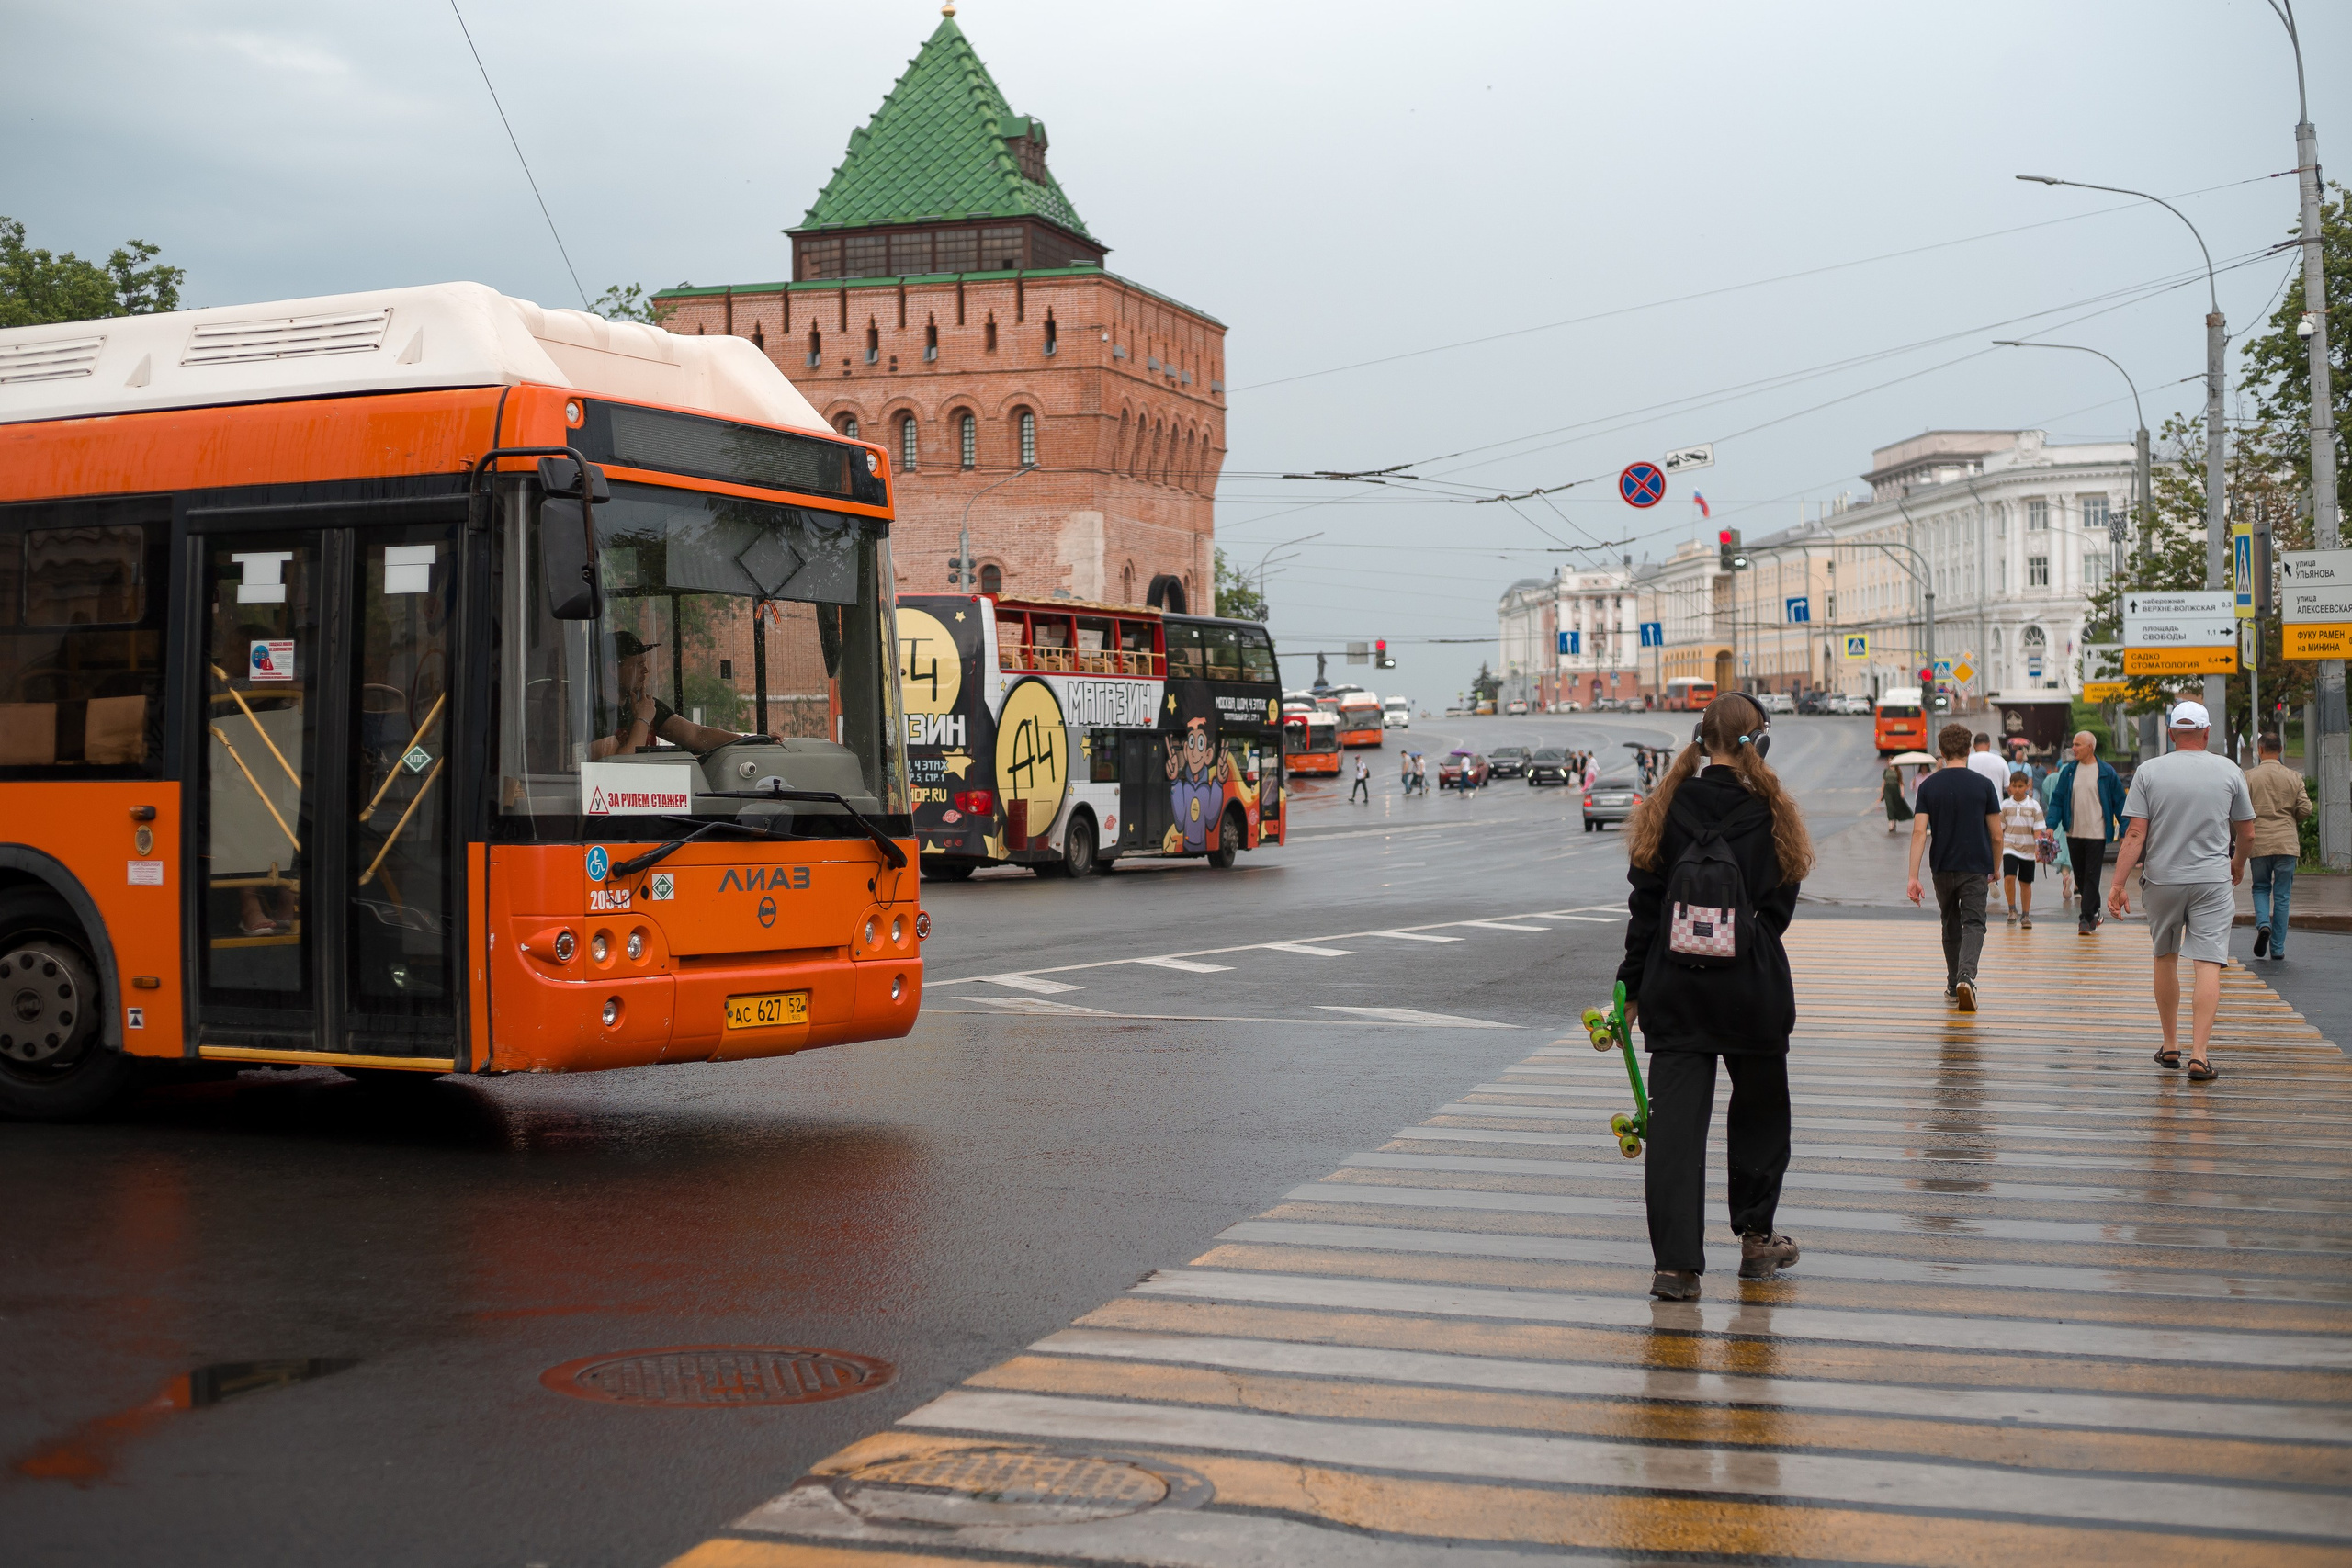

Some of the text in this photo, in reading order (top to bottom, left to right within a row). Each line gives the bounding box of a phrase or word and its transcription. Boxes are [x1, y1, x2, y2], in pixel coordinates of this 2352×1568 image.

[2296, 560, 2316, 570] улица
[2296, 569, 2335, 579] УЛЬЯНОВА
[2143, 598, 2185, 606] набережная
[2297, 595, 2317, 604] улица
[2297, 604, 2352, 614] АЛЕКСЕЕВСКАЯ
[2143, 633, 2187, 641] СВОБОДЫ
[2297, 630, 2345, 639] ФУКУ РАМЕН
[2308, 643, 2340, 652] МИНИНА
[1068, 681, 1152, 727] МАГАЗИН
[410, 754, 424, 762] КПГ
[922, 760, 948, 771] ЭТАЖ
[925, 773, 940, 782] СТР.
[941, 773, 944, 782] 1
[608, 793, 687, 807] ЗА РУЛЕМ СТАЖЕР!
[718, 866, 810, 893] ЛИАЗ
[590, 889, 630, 910] 20543
[758, 999, 781, 1021] 627
[789, 998, 801, 1013] 52
